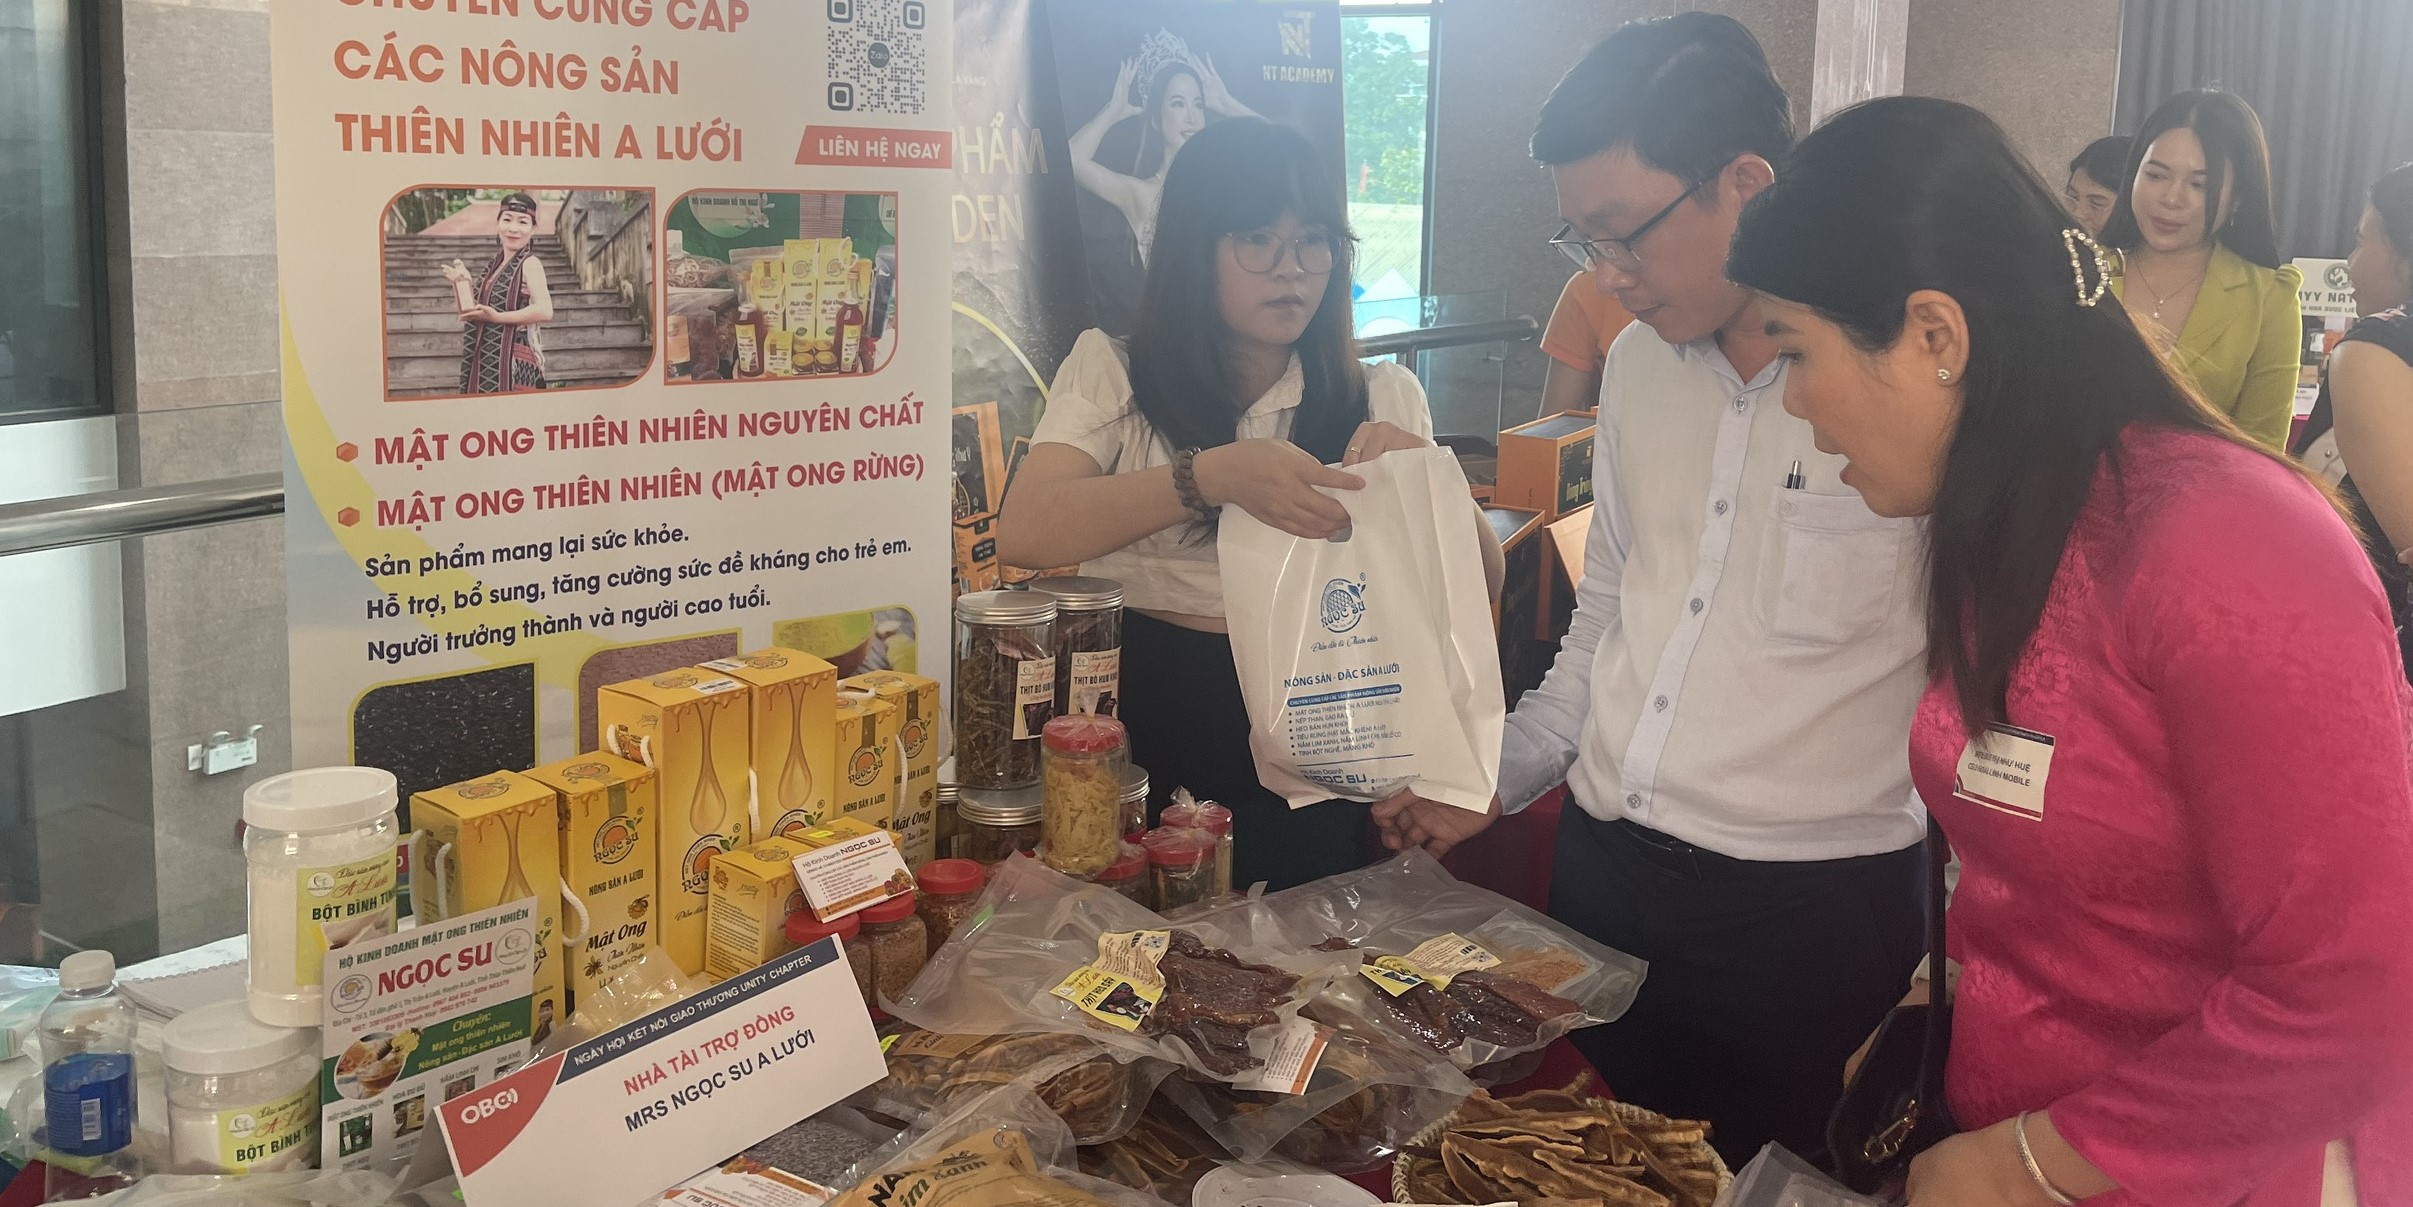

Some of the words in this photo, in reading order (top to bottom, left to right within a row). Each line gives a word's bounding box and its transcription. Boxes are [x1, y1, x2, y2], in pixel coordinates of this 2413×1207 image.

[334, 31, 444, 84] CÁC
[461, 40, 588, 90] NÔNG
[600, 45, 679, 95] SẢN
[1263, 65, 1278, 81] NT
[1281, 66, 1335, 84] ACADEMY
[334, 105, 464, 155] THIÊN
[481, 112, 600, 159] NHIÊN
[614, 124, 643, 160] A
[656, 117, 743, 162] LƯỚI
[819, 134, 859, 157] LIÊN
[865, 136, 889, 163] HỆ
[894, 142, 941, 159] NGAY
[374, 427, 450, 472] MẬT
[459, 427, 535, 461] ONG
[543, 414, 630, 452] THIÊN
[638, 408, 729, 446] NHIÊN
[737, 401, 852, 439] NGUYÊN
[859, 392, 926, 431] CHẤT
[376, 489, 446, 532] MẬT
[454, 486, 526, 521] ONG
[533, 474, 611, 510] THIÊN
[619, 466, 703, 503] NHIÊN
[712, 460, 780, 500] (MẬT
[786, 460, 847, 491] ONG
[852, 453, 926, 485] RỪNG)
[364, 551, 413, 579] Sản
[418, 540, 486, 580] phẩm
[491, 541, 553, 567] mang
[558, 530, 586, 559] lại
[591, 528, 630, 553] sức
[633, 524, 690, 548] khỏe.
[367, 592, 401, 620] Hỗ
[407, 590, 447, 619] trợ,
[453, 580, 485, 612] bổ
[489, 582, 547, 607] sung,
[551, 571, 601, 601] tăng
[606, 564, 673, 592] cường
[677, 557, 714, 581] sức
[717, 550, 746, 576] đề
[749, 546, 811, 574] kháng
[815, 541, 851, 564] cho
[854, 537, 878, 560] trẻ
[881, 538, 913, 556] em.
[367, 633, 439, 664] Người
[445, 622, 516, 652] trưởng
[522, 613, 583, 640] thành
[588, 606, 615, 630] và
[620, 599, 680, 629] người
[684, 594, 724, 615] cao
[728, 584, 772, 611] tuổi.
[1284, 676, 1314, 688] NÔNG
[2002, 772, 2031, 787] MOBILE
[2014, 759, 2032, 774] HUỆ
[840, 841, 868, 855] NGỌC
[868, 837, 881, 846] SU
[911, 810, 931, 828] Ong
[312, 903, 342, 923] BỘT
[346, 896, 377, 917] BÌNH
[356, 947, 382, 966] KINH
[384, 937, 420, 959] DOANH
[421, 930, 444, 948] MẬT
[446, 925, 468, 940] ONG
[469, 914, 498, 935] THIÊN
[499, 908, 530, 928] NHIÊN
[585, 929, 615, 952] Mật
[617, 920, 648, 941] Ong
[377, 952, 452, 997] NGỌC
[457, 941, 493, 972] SU
[573, 1043, 605, 1067] NGÀY
[606, 1036, 626, 1054] HỘI
[669, 1006, 696, 1024] GIAO
[695, 986, 740, 1013] THƯƠNG
[739, 973, 768, 997] UNITY
[768, 954, 813, 981] CHAPTER
[622, 1062, 668, 1096] NHÀ
[666, 1047, 701, 1082] TÀI
[700, 1029, 740, 1064] TRỢ
[623, 1098, 669, 1133] MRS
[672, 1071, 726, 1112] NGỌC
[728, 1058, 755, 1083] SU
[756, 1053, 773, 1071] A
[772, 1026, 816, 1065] LƯỚI
[236, 1144, 266, 1163] BỘT
[270, 1130, 301, 1154] BÌNH
